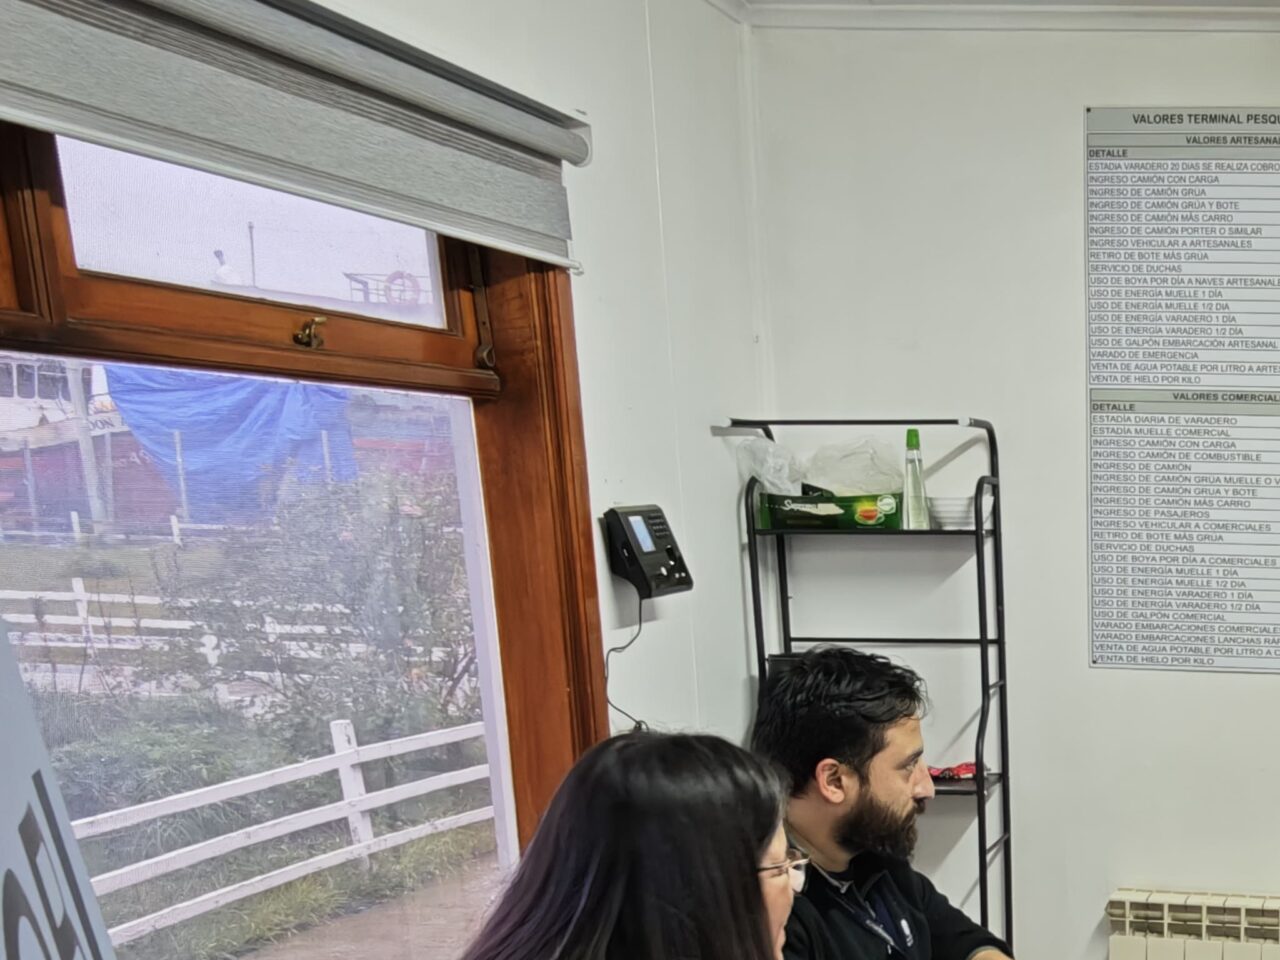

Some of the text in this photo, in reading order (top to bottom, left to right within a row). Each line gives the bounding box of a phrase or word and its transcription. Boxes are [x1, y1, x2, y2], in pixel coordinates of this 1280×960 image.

[1132, 114, 1185, 125] VALORES
[1188, 114, 1244, 125] TERMINAL
[1186, 136, 1228, 145] VALORES
[1090, 175, 1129, 184] INGRESO
[1167, 176, 1186, 184] CON
[1189, 176, 1219, 184] CARGA
[1090, 214, 1129, 222] INGRESO
[1202, 214, 1233, 223] CARRO
[1090, 239, 1129, 247] INGRESO
[1132, 240, 1181, 248] VEHICULAR
[1190, 240, 1252, 248] ARTESANALES
[1090, 264, 1130, 273] SERVICIO
[1146, 265, 1182, 273] DUCHAS
[1090, 277, 1109, 285] USO
[1126, 277, 1149, 285] BOYA
[1151, 278, 1170, 286] POR
[1196, 278, 1224, 286] NAVES
[1090, 289, 1109, 297] USO
[1165, 290, 1199, 298] MUELLE
[1091, 363, 1119, 371] VENTA
[1135, 364, 1159, 372] AGUA
[1160, 364, 1199, 373] POTABLE
[1201, 365, 1220, 373] POR
[1222, 365, 1247, 373] LITRO
[1092, 375, 1119, 383] VENTA
[1161, 376, 1179, 384] POR
[1182, 376, 1200, 384] KILO
[1173, 393, 1219, 401] VALORES
[1135, 416, 1166, 424] DIARIA
[1184, 417, 1237, 425] VARADERO
[1134, 428, 1172, 436] MUELLE
[1174, 428, 1230, 437] COMERCIAL
[1093, 463, 1136, 471] INGRESO
[1093, 509, 1136, 517] INGRESO
[1154, 510, 1210, 518] PASAJEROS
[1093, 520, 1136, 529] INGRESO
[1139, 521, 1192, 530] VEHICULAR
[1203, 523, 1271, 532] COMERCIALES
[1094, 543, 1137, 552] SERVICIO
[1155, 544, 1194, 552] DUCHAS
